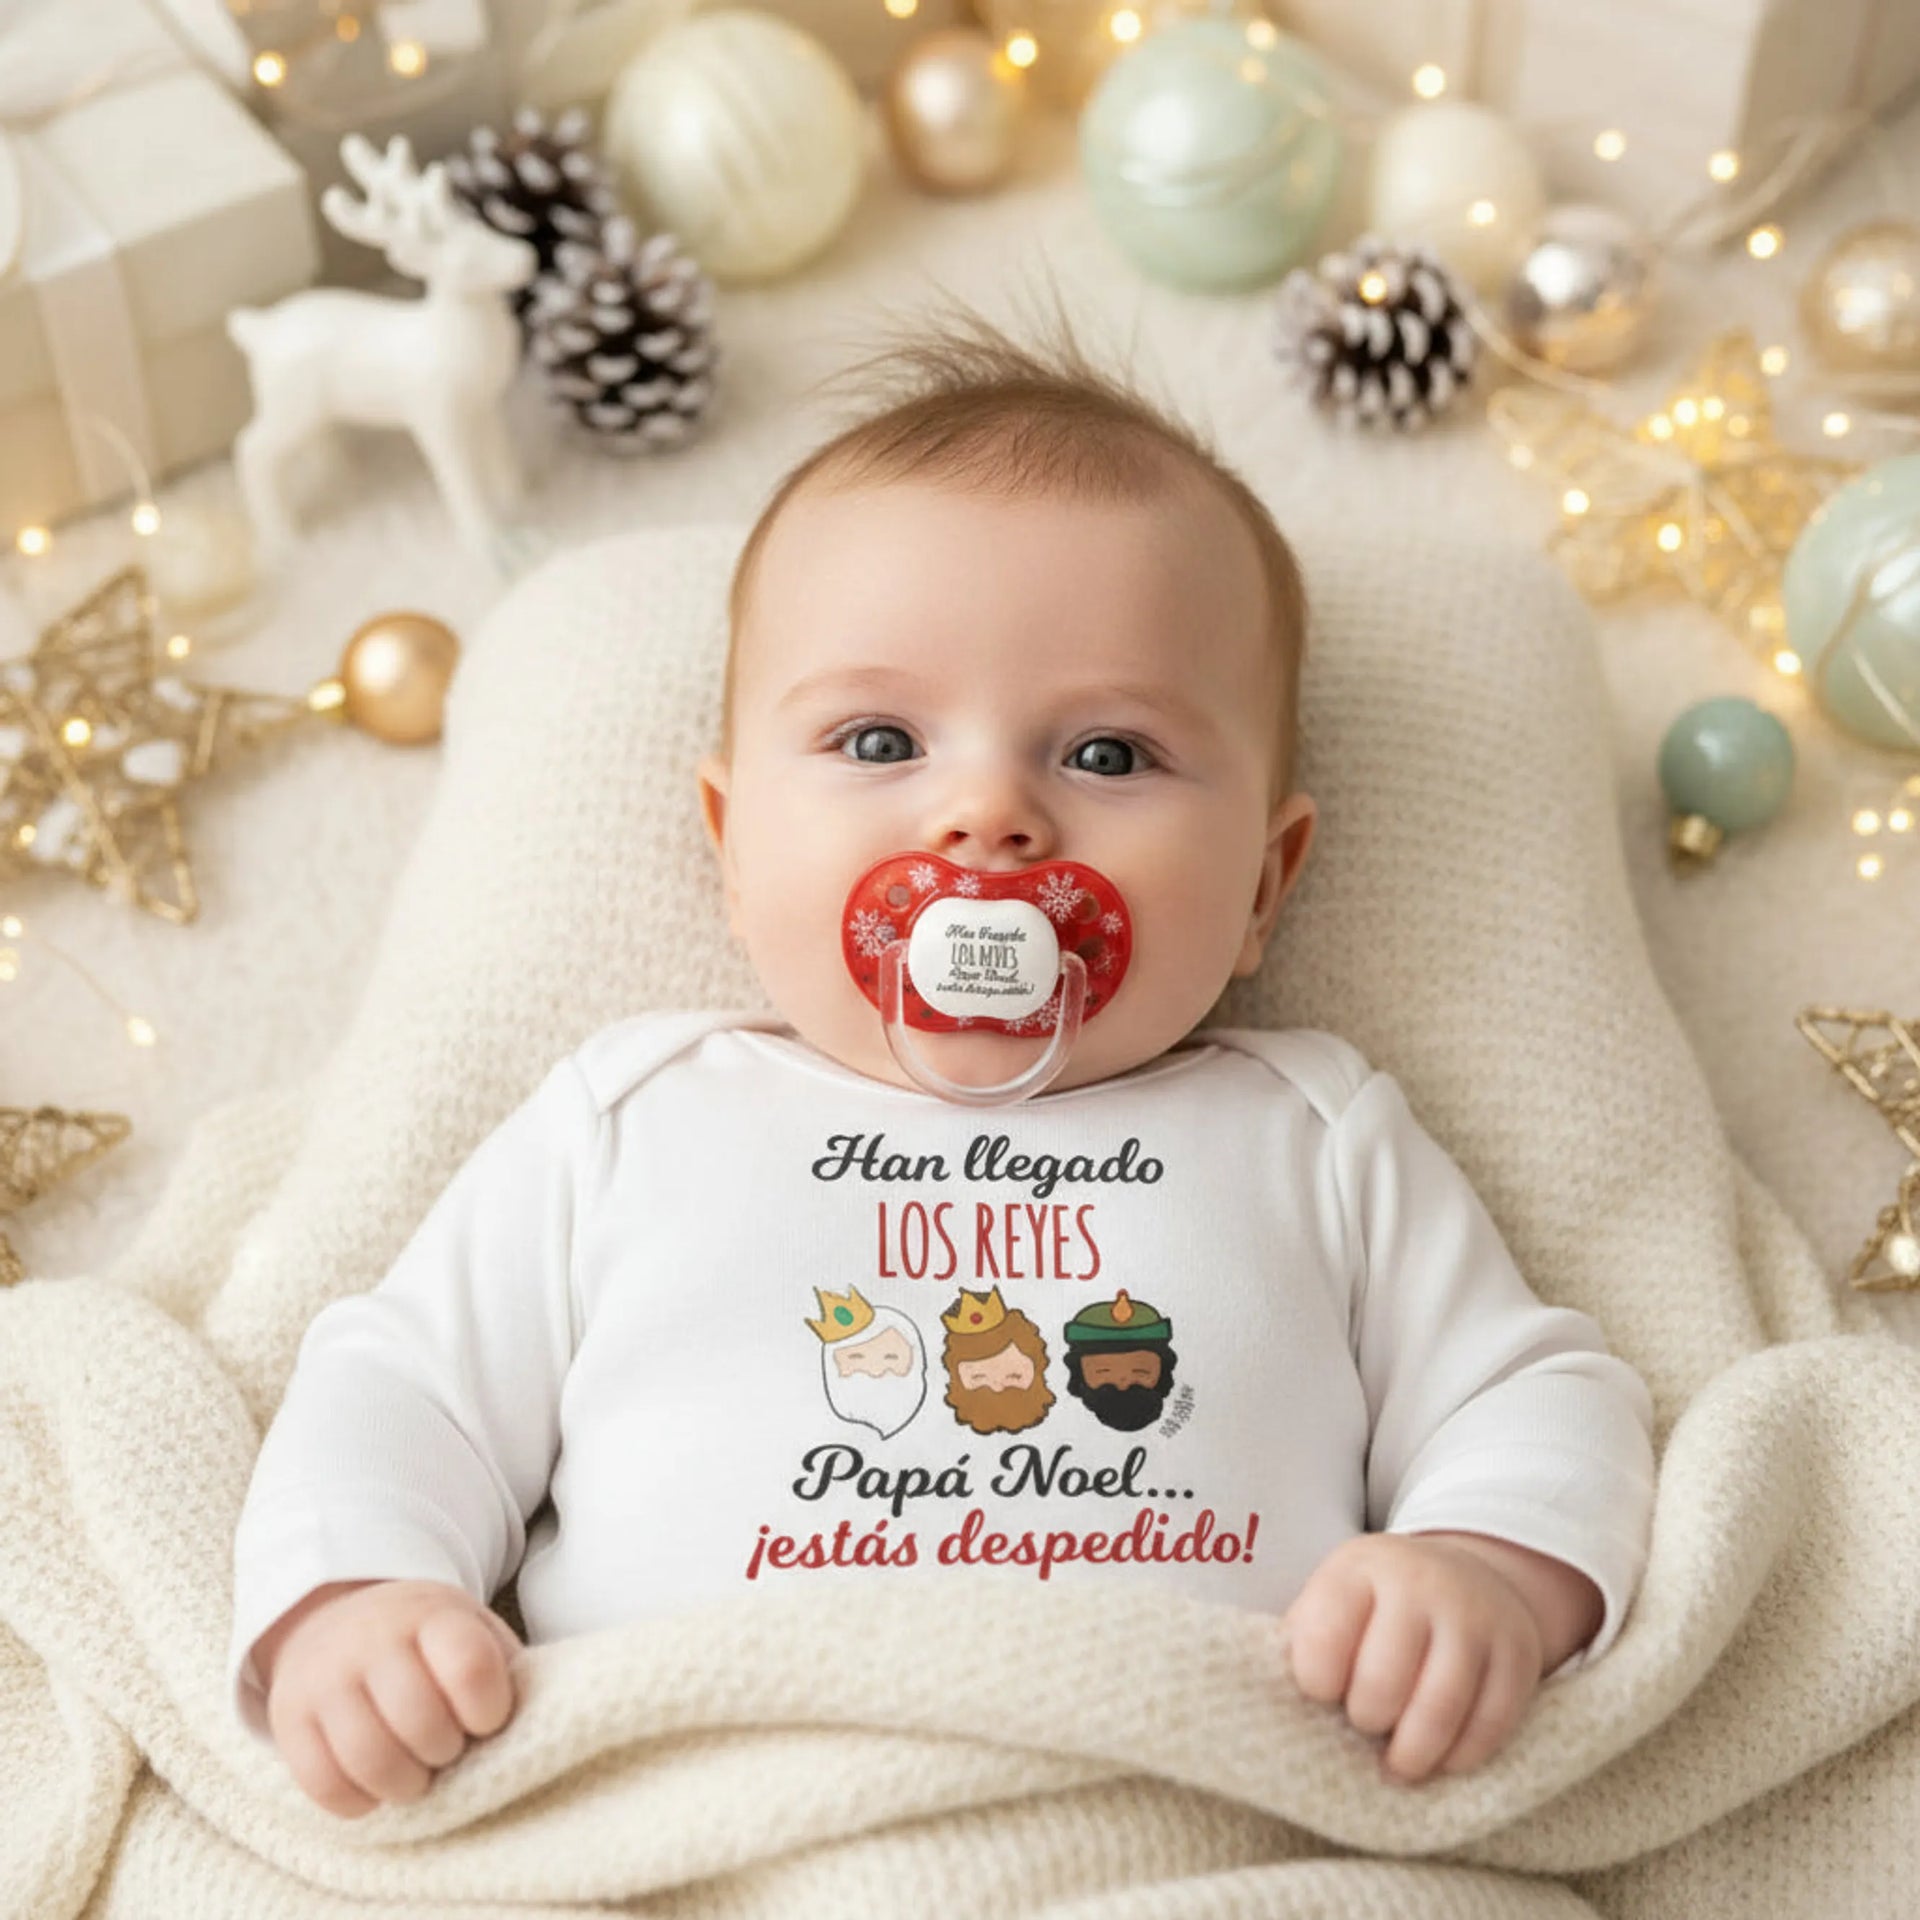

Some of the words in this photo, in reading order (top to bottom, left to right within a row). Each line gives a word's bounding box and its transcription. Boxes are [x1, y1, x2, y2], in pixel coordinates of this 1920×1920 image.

[811, 1133, 950, 1184] Han
[963, 1135, 1165, 1199] llegado
[878, 1201, 957, 1280] LOS
[976, 1203, 1101, 1281] REYES
[792, 1443, 974, 1518] Papá
[991, 1445, 1194, 1499] Noel...
[745, 1518, 919, 1581] ¡estás
[937, 1508, 1259, 1582] despedido!
